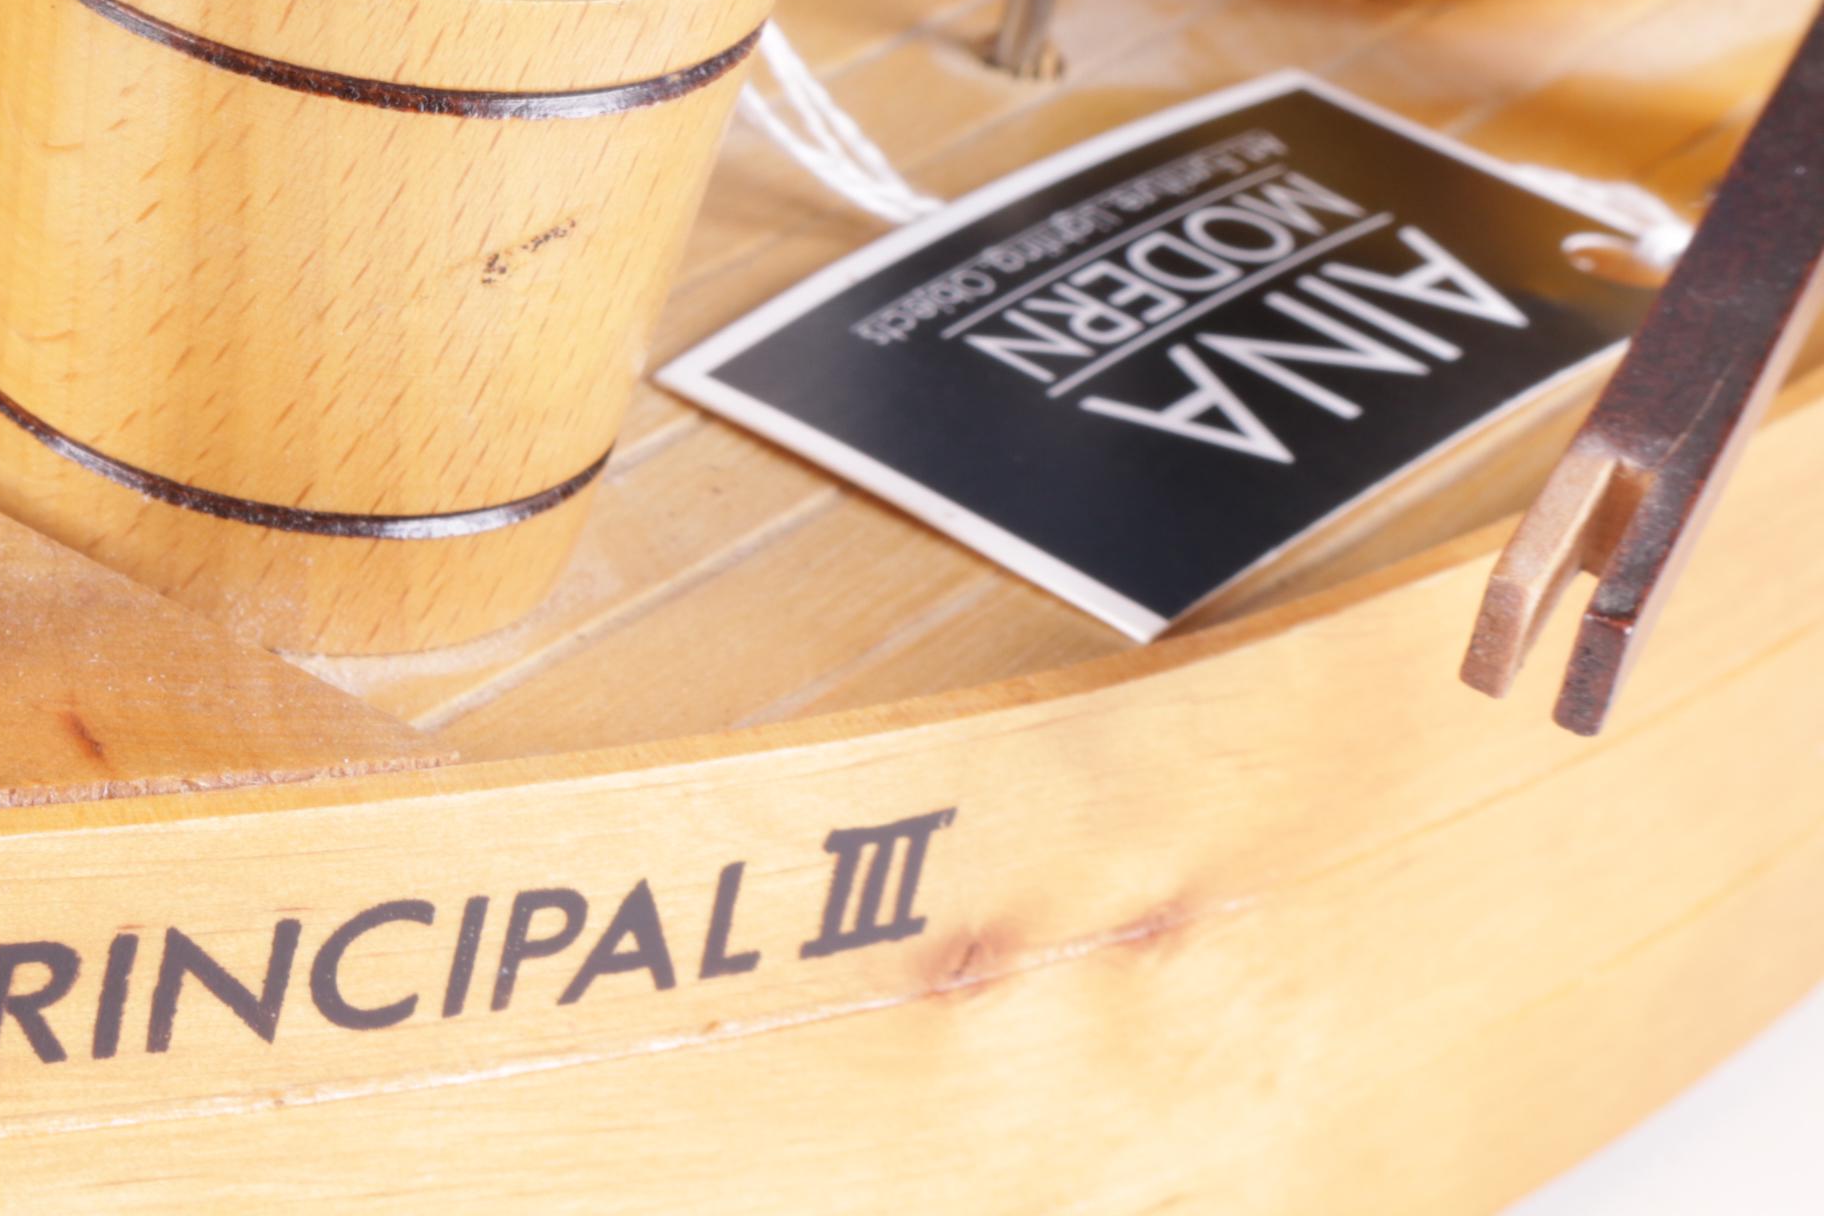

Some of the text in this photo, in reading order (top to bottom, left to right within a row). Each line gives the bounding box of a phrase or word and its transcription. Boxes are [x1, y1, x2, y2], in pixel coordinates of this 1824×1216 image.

[964, 170, 1367, 383] MODERN
[1080, 224, 1530, 465] AINA
[799, 806, 958, 960] III
